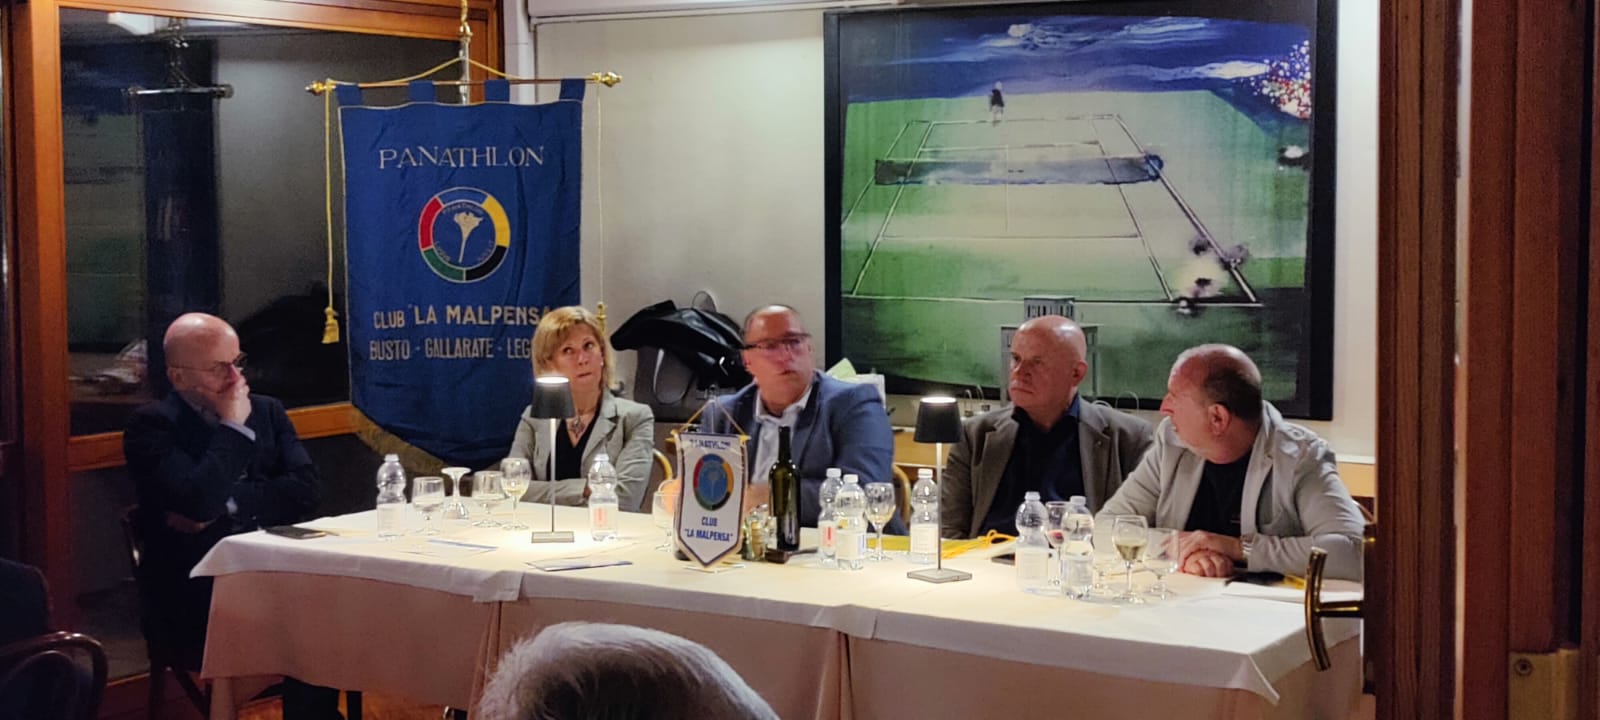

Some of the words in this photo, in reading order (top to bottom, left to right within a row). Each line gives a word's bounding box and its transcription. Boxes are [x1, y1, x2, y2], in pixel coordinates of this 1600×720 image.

[379, 146, 544, 169] PANATHLON
[373, 310, 406, 329] CLUB
[369, 339, 411, 361] BUSTO
[425, 337, 495, 359] GALLARATE
[507, 337, 531, 359] LEG
[701, 516, 718, 527] CLUB
